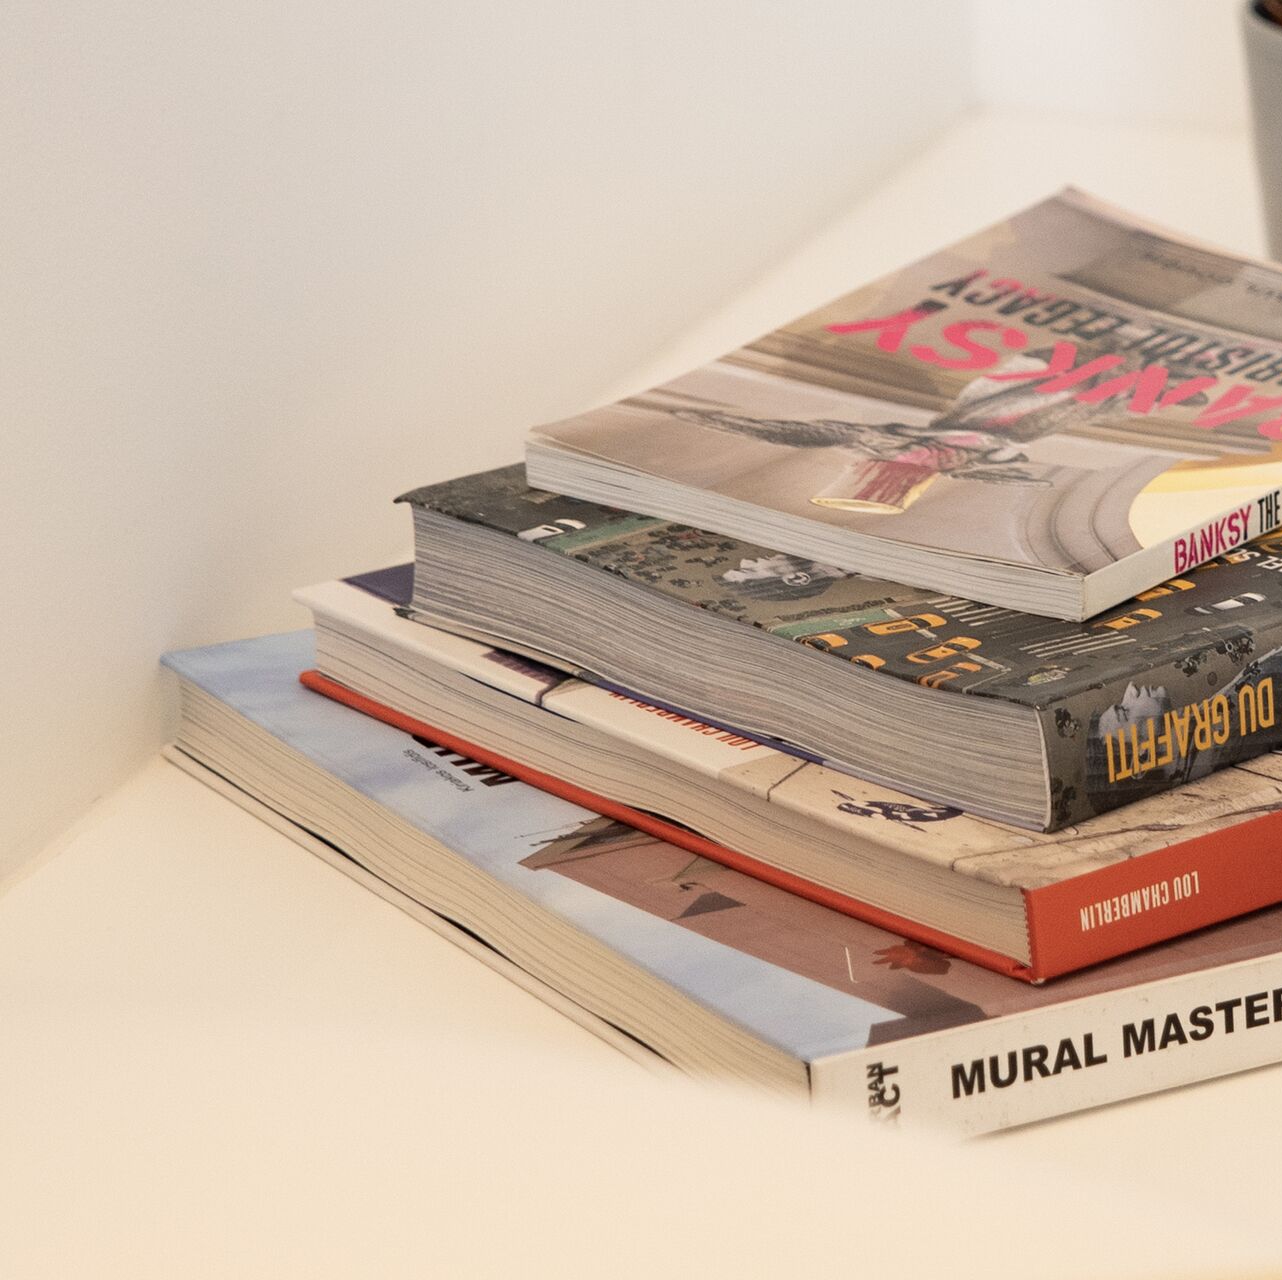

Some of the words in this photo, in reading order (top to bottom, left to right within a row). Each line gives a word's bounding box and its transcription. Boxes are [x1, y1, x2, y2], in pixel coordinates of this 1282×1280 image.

[932, 269, 1127, 345] LEGACY
[1173, 504, 1252, 575] BANKSY
[1257, 489, 1281, 534] THE
[1105, 694, 1231, 784] GRAFFITI
[1238, 677, 1276, 737] DU
[1079, 880, 1170, 932] CHAMBERLIN
[1173, 870, 1200, 902] LOU
[950, 1032, 1108, 1100] MURAL
